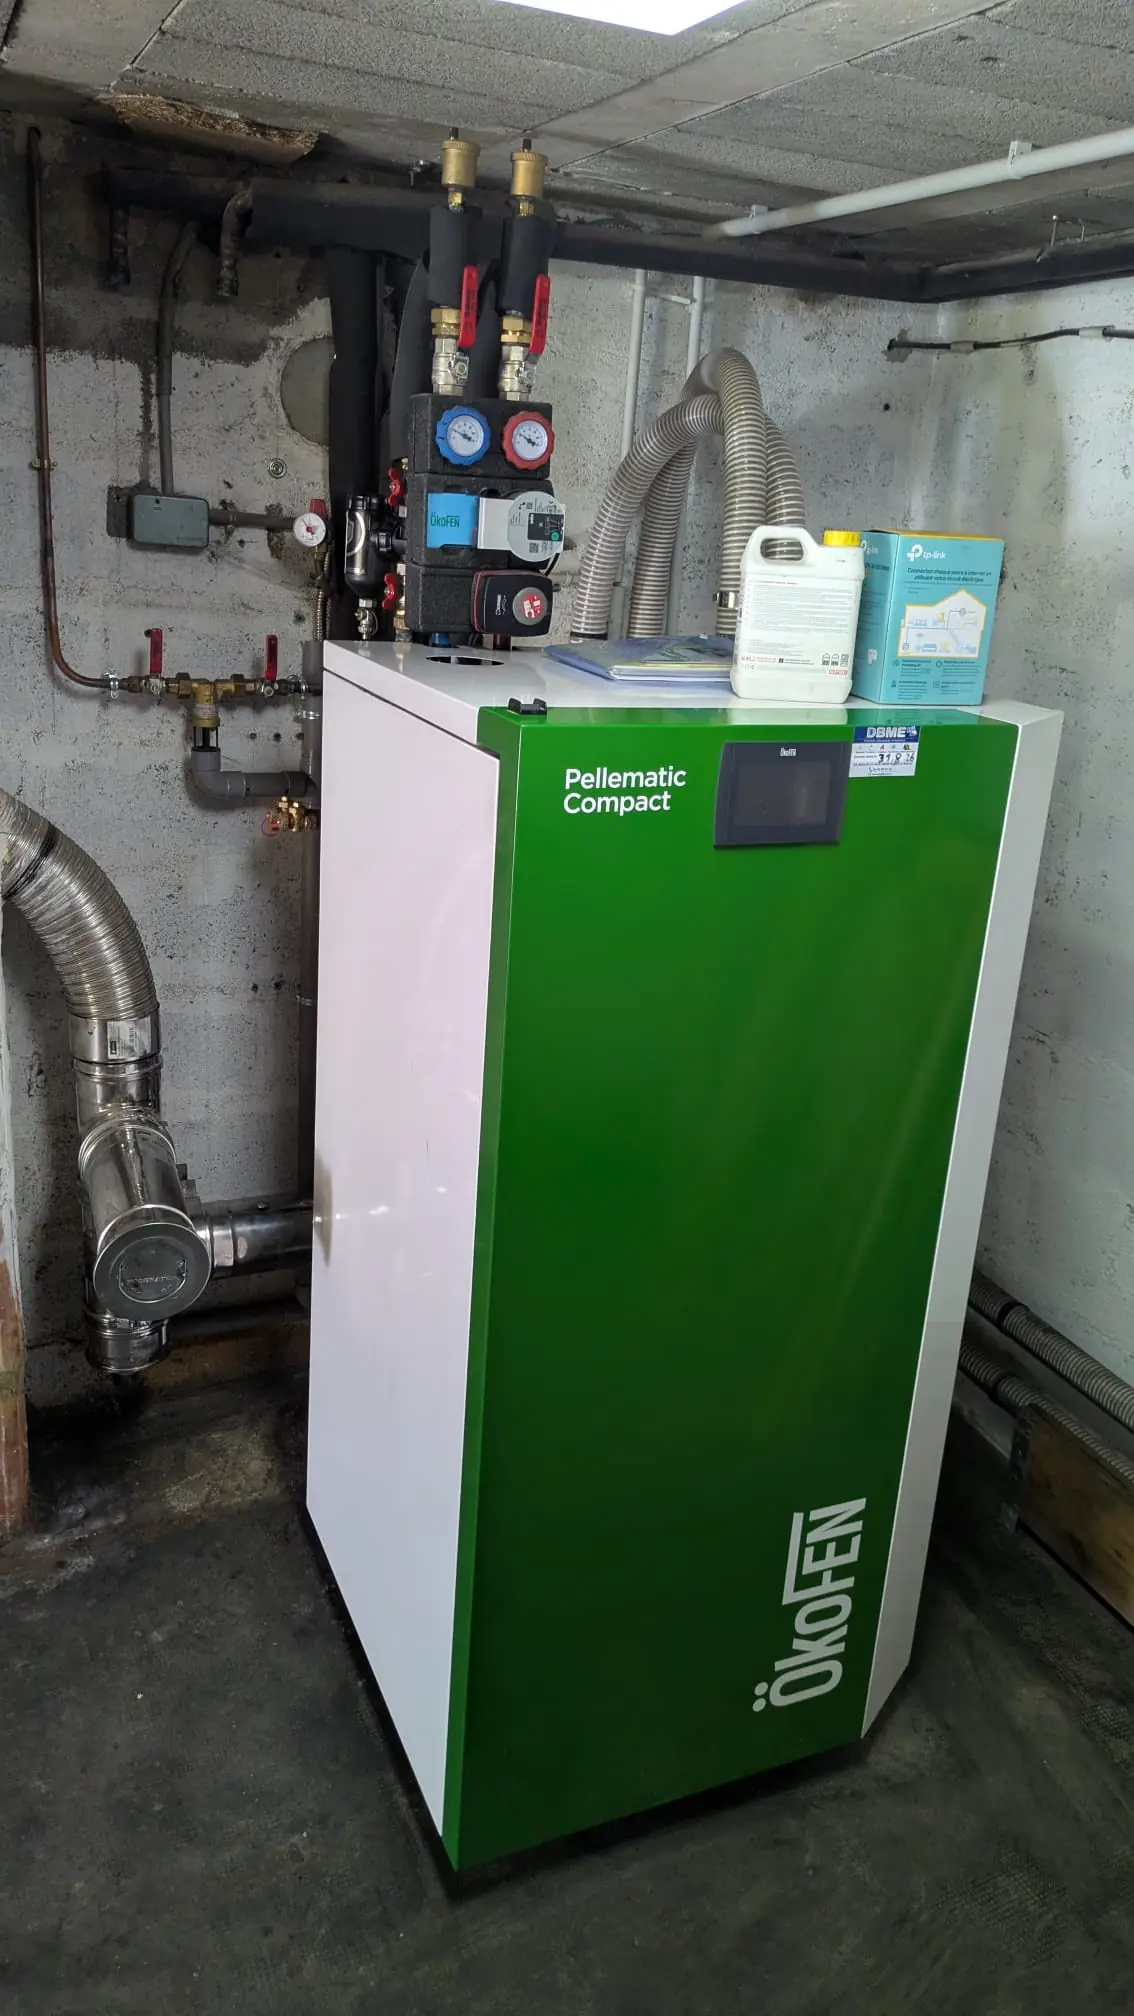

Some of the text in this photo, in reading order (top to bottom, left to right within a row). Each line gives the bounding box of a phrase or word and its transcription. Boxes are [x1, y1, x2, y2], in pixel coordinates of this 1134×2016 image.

[923, 551, 946, 559] tp-link
[866, 726, 906, 738] DBME
[564, 766, 687, 789] Pellematic
[563, 790, 671, 816] Compact
